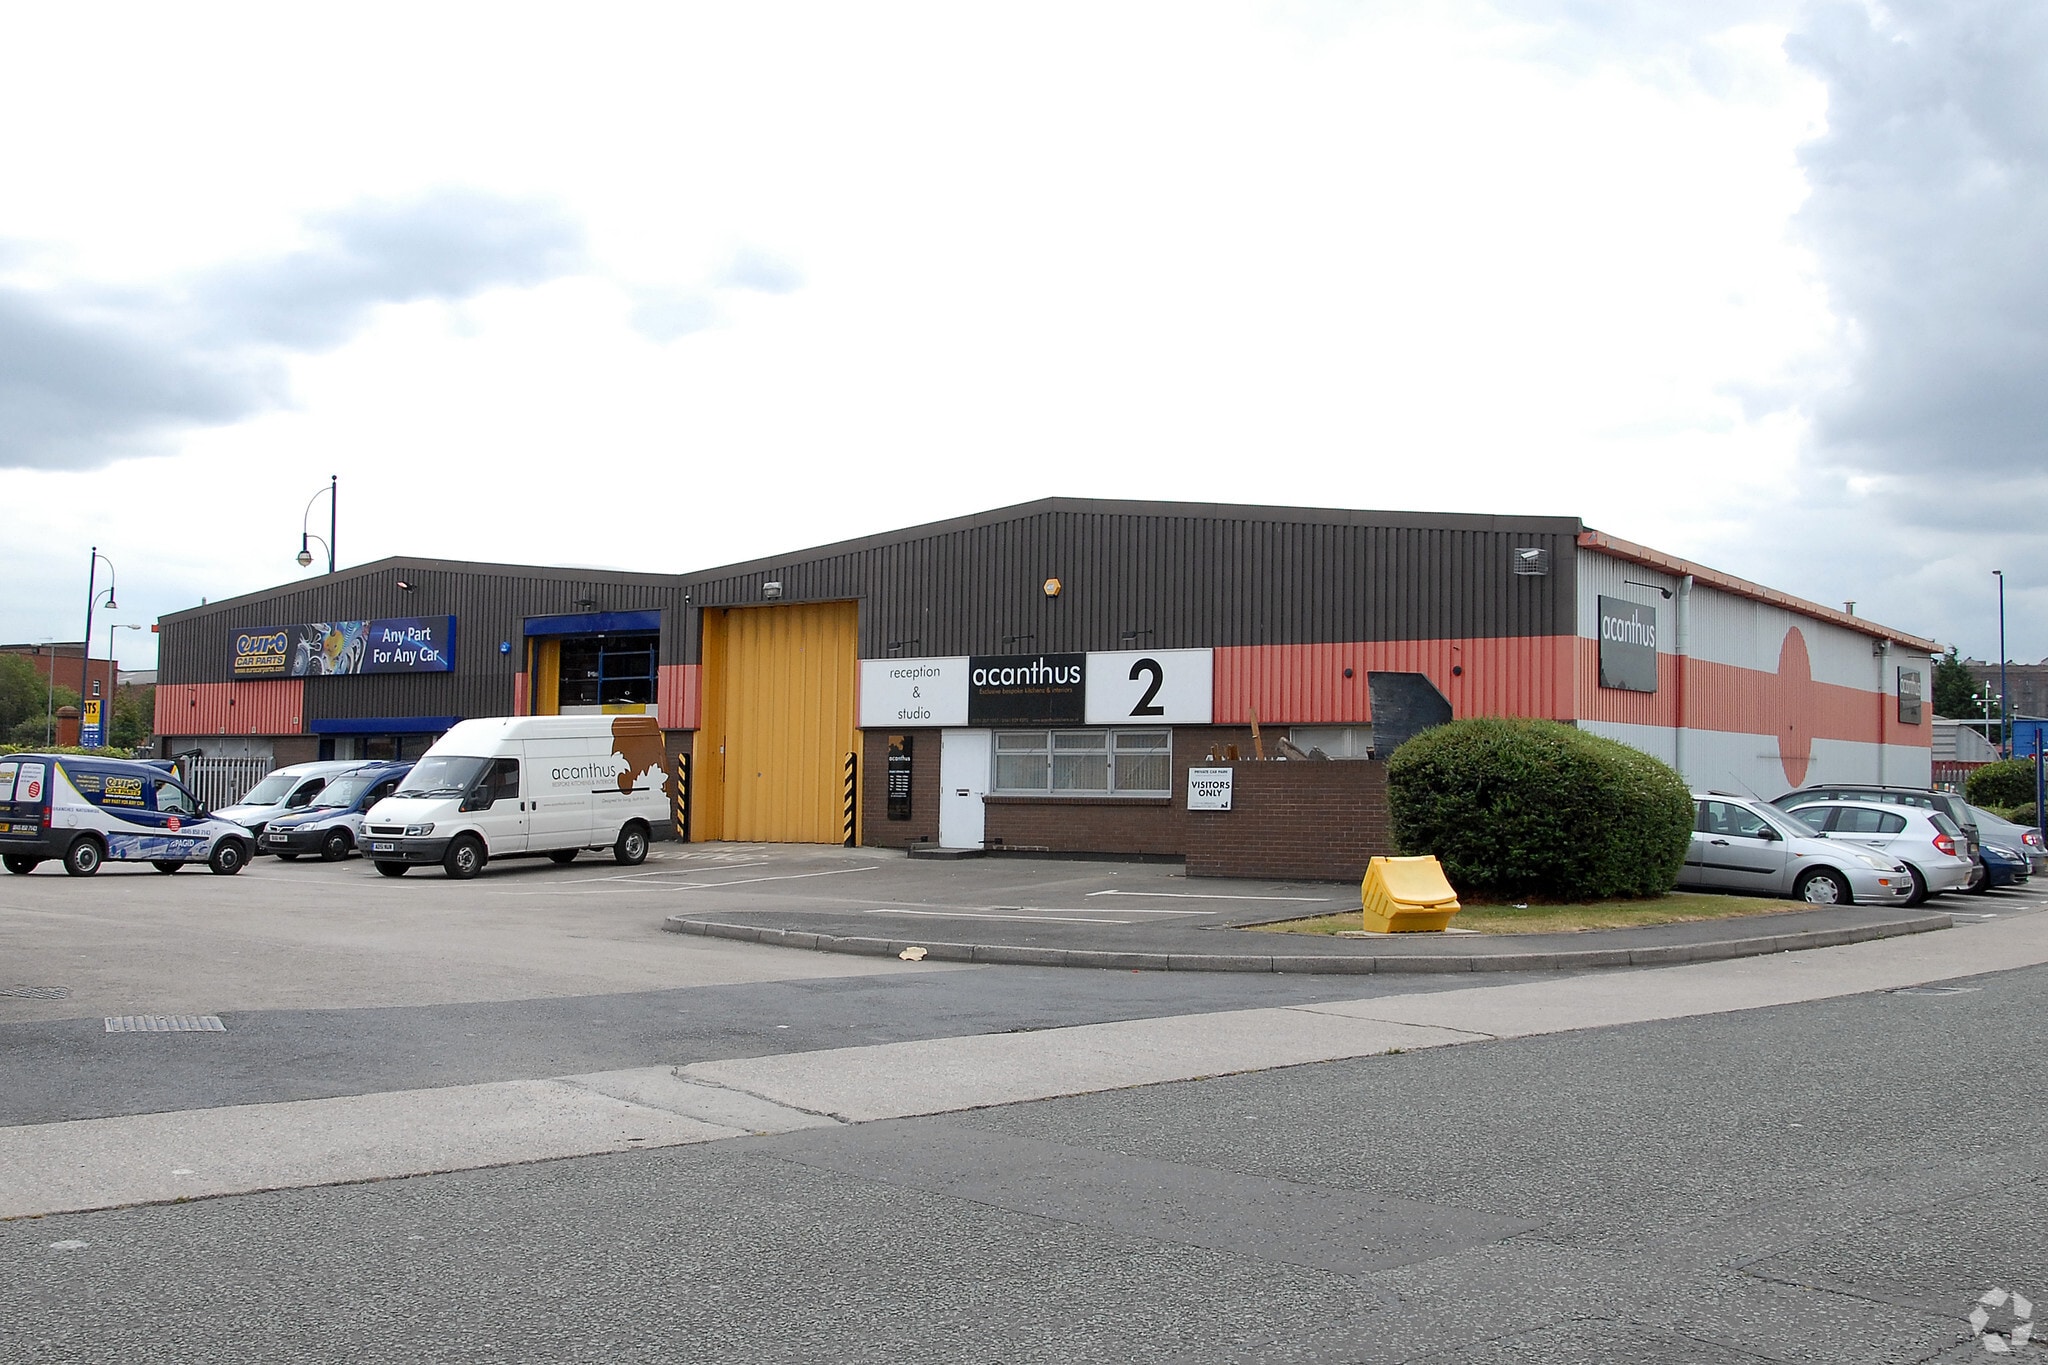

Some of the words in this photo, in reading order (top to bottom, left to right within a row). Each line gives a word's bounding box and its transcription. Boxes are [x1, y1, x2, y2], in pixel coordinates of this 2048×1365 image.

[382, 628, 404, 646] Any
[407, 627, 431, 641] Part
[1602, 608, 1655, 648] acanthus
[236, 631, 288, 656] euro
[236, 657, 254, 667] CAR
[255, 656, 283, 666] PARTS
[373, 649, 392, 663] For
[393, 650, 416, 665] Any
[419, 648, 439, 662] Car
[889, 664, 941, 681] reception
[972, 656, 1080, 686] acanthus
[912, 685, 921, 698] &
[1128, 658, 1164, 716] 2
[898, 707, 931, 720] studio
[551, 763, 616, 780] acanthus
[1191, 781, 1230, 789] VISITORS
[1198, 789, 1222, 797] ONLY
[175, 838, 195, 847] PAGID
